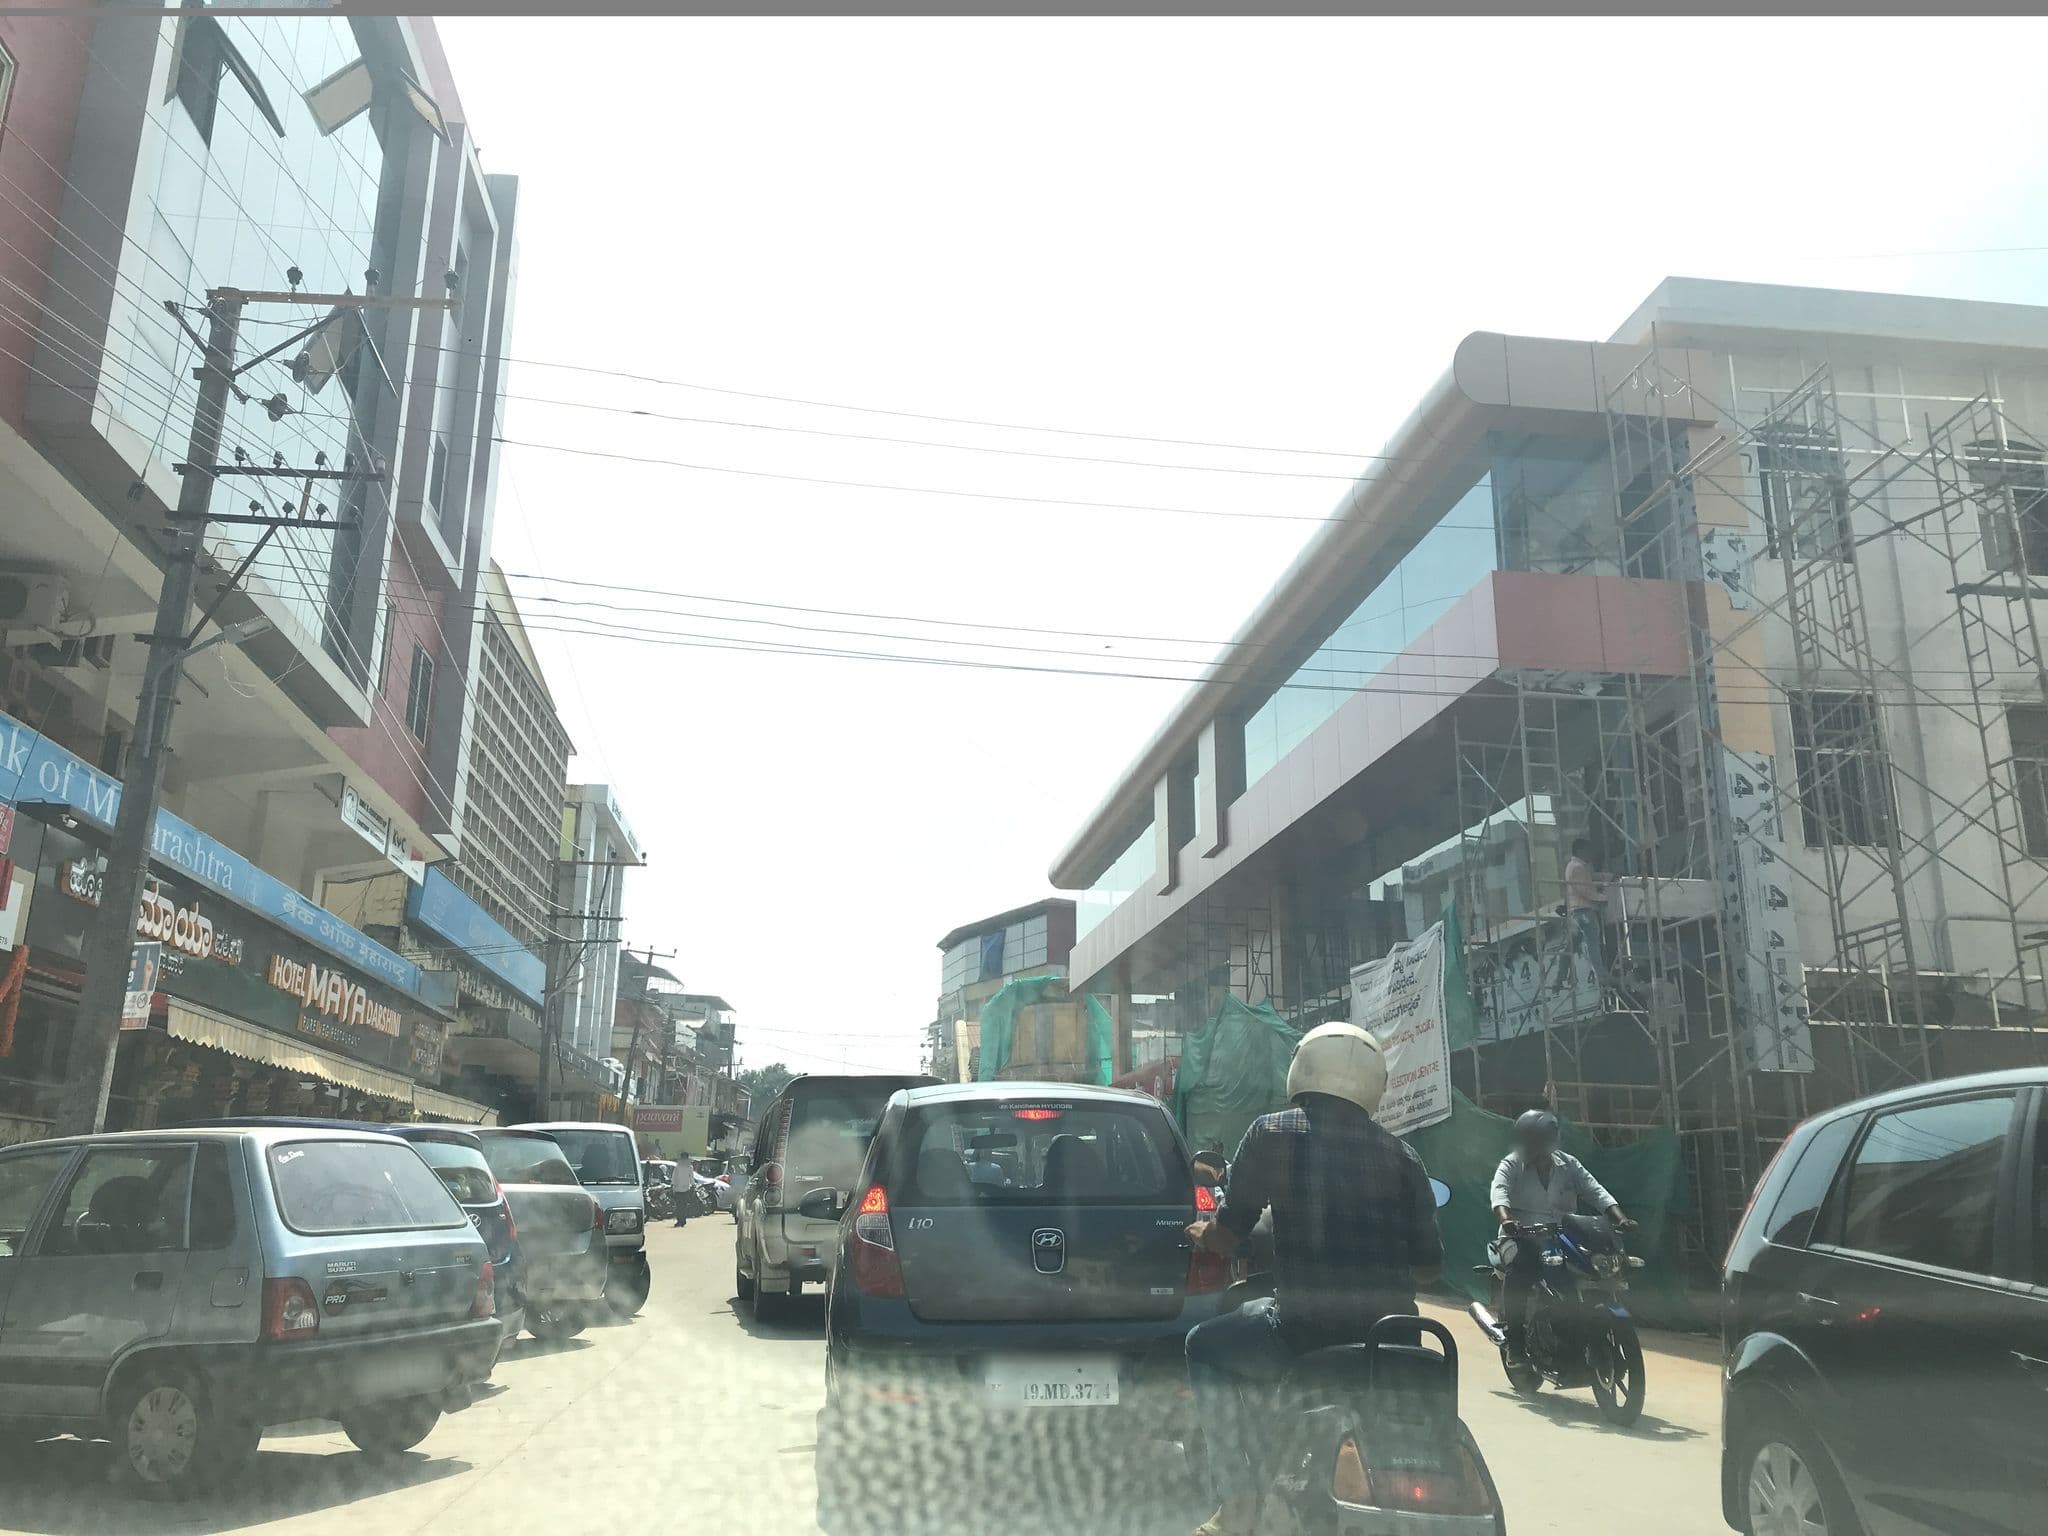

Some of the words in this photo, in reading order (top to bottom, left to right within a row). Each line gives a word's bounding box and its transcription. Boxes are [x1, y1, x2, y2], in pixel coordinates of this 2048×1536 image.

[39, 760, 80, 802] of
[272, 954, 306, 998] HOTEL
[366, 999, 402, 1037] DARSHINI
